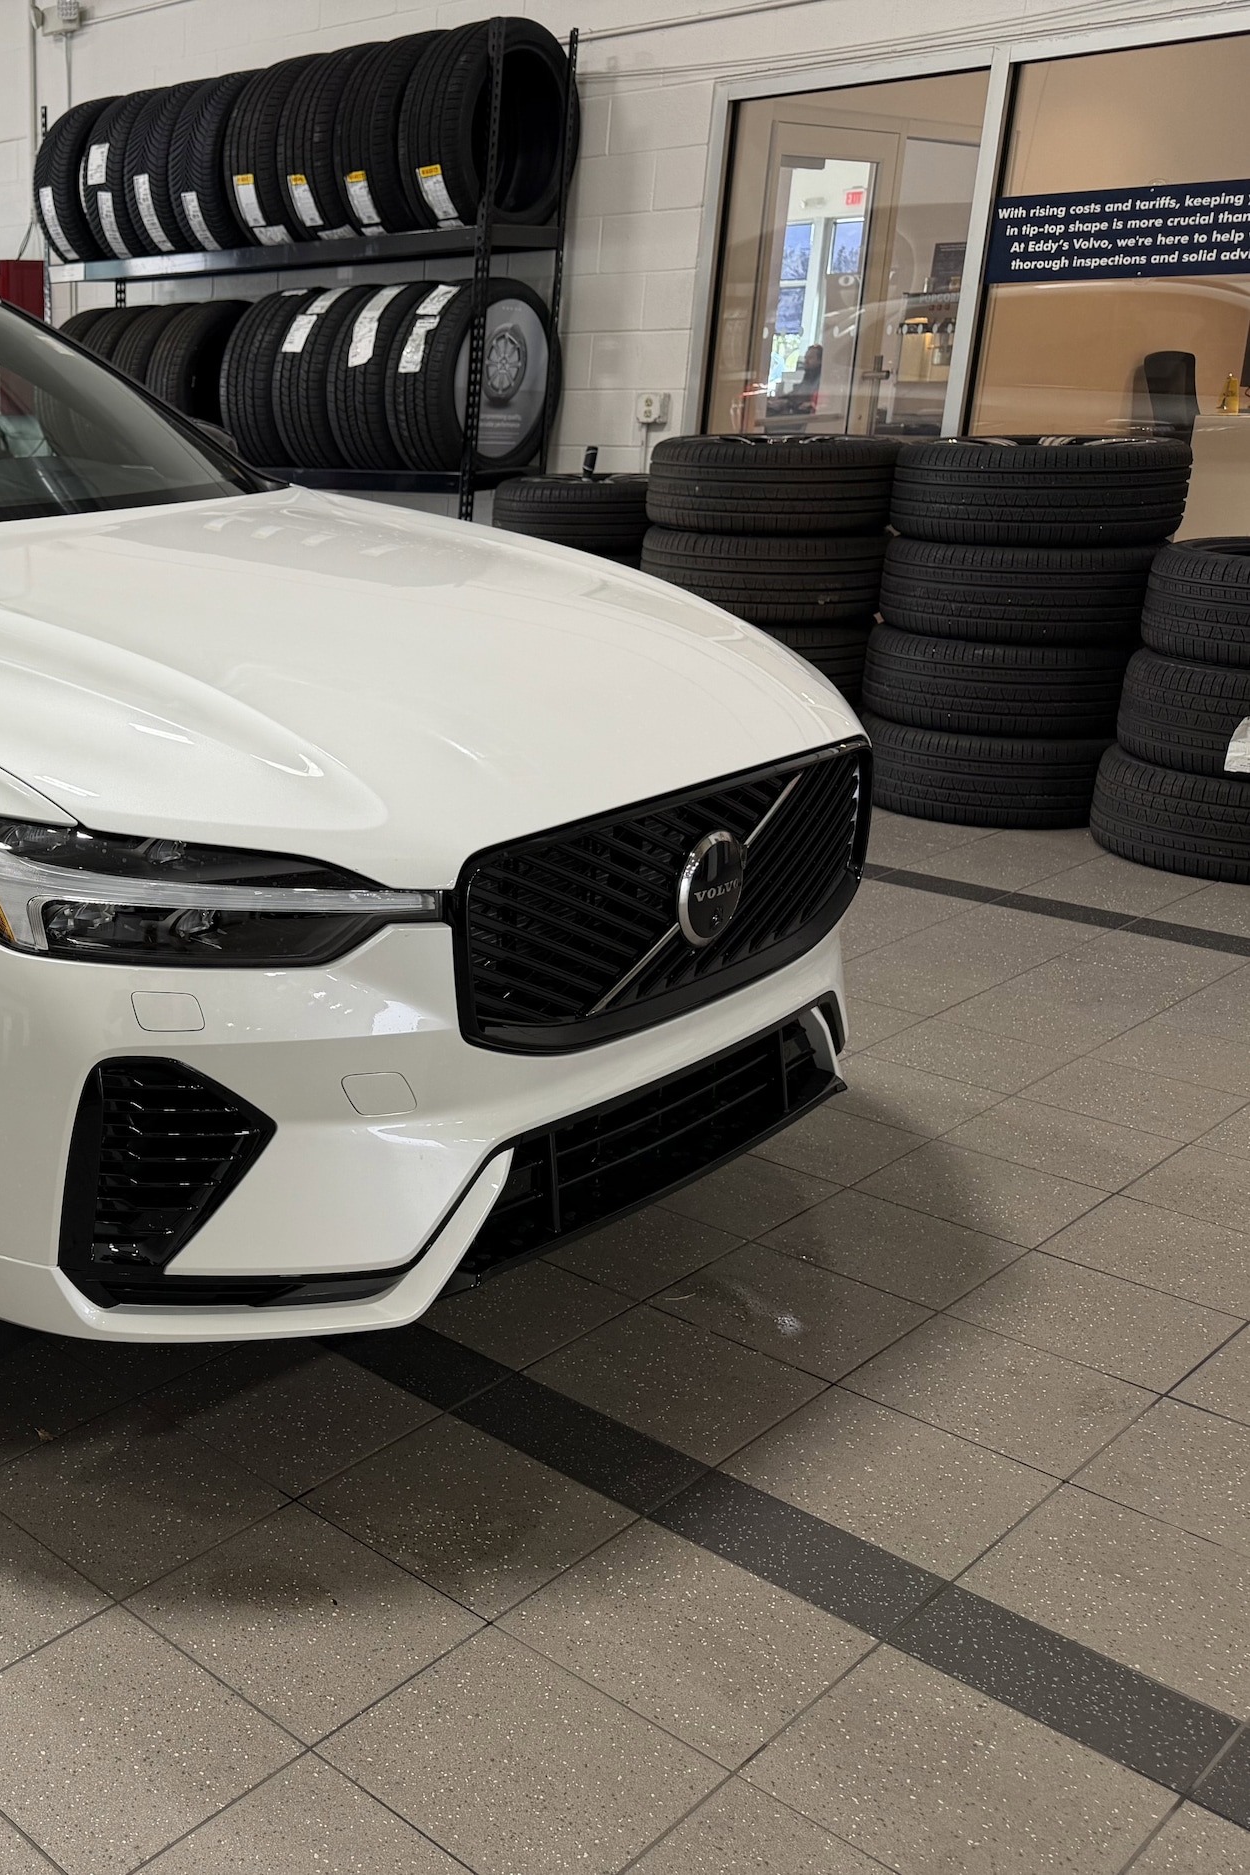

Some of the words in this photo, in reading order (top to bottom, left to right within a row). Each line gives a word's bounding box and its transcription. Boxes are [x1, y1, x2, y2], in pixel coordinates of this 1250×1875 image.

[998, 206, 1027, 219] With
[1030, 205, 1066, 218] rising
[1070, 203, 1101, 214] costs
[1104, 199, 1132, 212] and
[1135, 196, 1180, 210] tariffs,
[1184, 193, 1244, 208] keeping
[1006, 225, 1018, 236] in
[1022, 223, 1065, 237] tip-top
[1068, 220, 1108, 233] shape
[1112, 218, 1123, 229] is
[1127, 218, 1163, 229] more
[1167, 212, 1214, 226] crucial
[1218, 211, 1250, 223] than
[1010, 242, 1025, 253] At
[1028, 239, 1069, 254] Eddy’s
[1073, 237, 1113, 250] Volvo,
[1117, 235, 1153, 247] we're
[1156, 233, 1189, 245] here
[1193, 233, 1208, 244] to
[1211, 229, 1245, 244] help
[1011, 256, 1069, 271] thorough
[1072, 254, 1147, 269] inspections
[1150, 251, 1179, 264] and
[1181, 249, 1217, 262] solid
[693, 878, 739, 902] VOLVO
